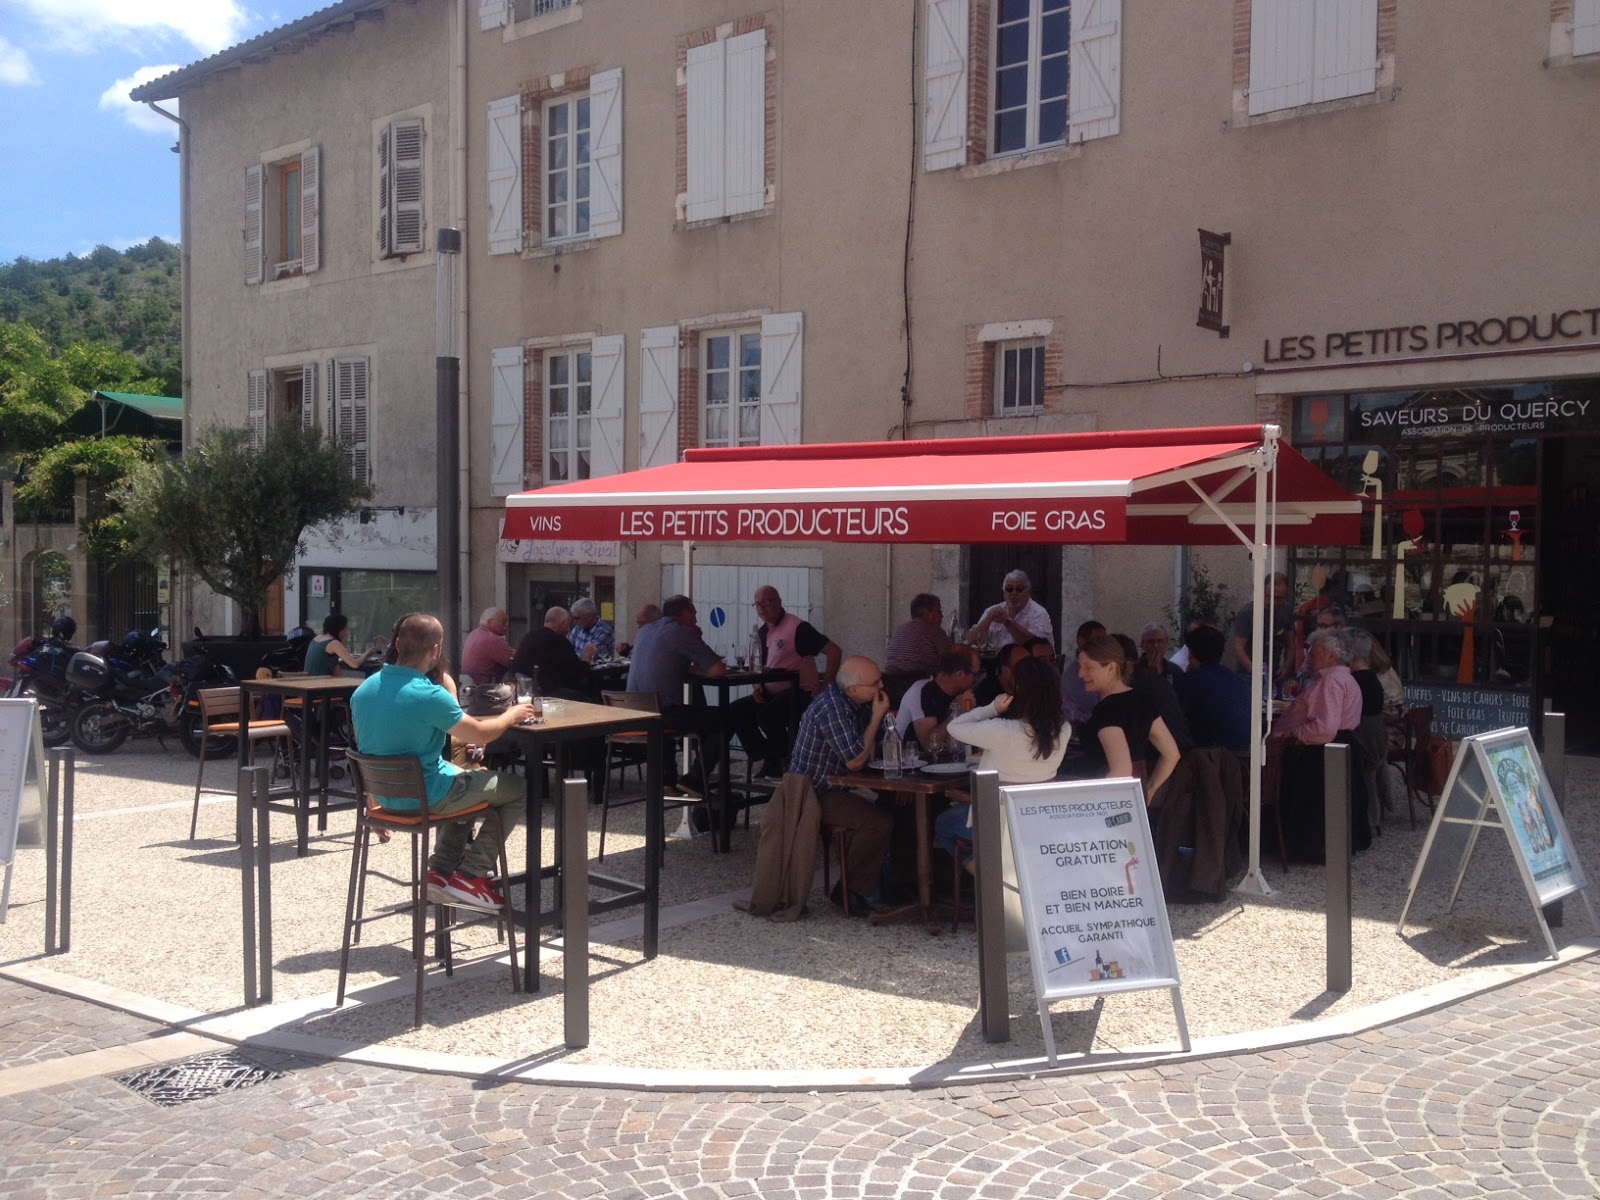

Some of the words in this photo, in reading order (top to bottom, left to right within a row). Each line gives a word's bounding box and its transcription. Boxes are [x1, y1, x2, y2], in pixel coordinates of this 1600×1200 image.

[1264, 335, 1315, 362] LES
[1326, 324, 1428, 358] PETITS
[1437, 308, 1600, 349] PRODUCT
[1361, 407, 1449, 427] SAVEURS
[1462, 405, 1491, 421] DU
[1500, 400, 1590, 420] QUERCY
[1401, 425, 1457, 435] ASSOCIATION
[1462, 425, 1474, 433] DE
[1479, 421, 1545, 432] PRODUCTEURS
[529, 515, 562, 532] VINS
[619, 511, 654, 536] LES
[662, 509, 728, 535] PETITS
[737, 507, 909, 535] PRODUCTEURS
[991, 511, 1037, 531] FOIE
[1044, 509, 1106, 530] GRAS
[522, 540, 575, 561] Jocelyne
[1404, 686, 1432, 701] TRUFFES
[1441, 689, 1461, 702] VINS
[1462, 692, 1472, 704] DE
[1474, 691, 1503, 706] CAHORS
[1512, 693, 1530, 708] FOIE
[1447, 705, 1464, 719] FOIE
[1466, 708, 1485, 721] GRAS
[1498, 709, 1529, 724] TRUFFES
[1020, 807, 1037, 816] LES
[1038, 804, 1068, 815] PETITS
[1068, 800, 1133, 812] PRODUCTEURS
[1049, 812, 1085, 820] ASSOCIATION
[1040, 839, 1128, 855] DEGUSTATION
[1056, 853, 1117, 867] GRATUITE
[1061, 889, 1087, 901] BIEN
[1091, 886, 1125, 898] BOIRE
[1046, 904, 1060, 915] ET
[1065, 902, 1091, 913] BIEN
[1094, 898, 1143, 911] MANGER
[1041, 924, 1083, 936] ACCUEIL
[1087, 917, 1156, 932] SYMPATHIQUE
[1078, 931, 1124, 943] GARANTI
